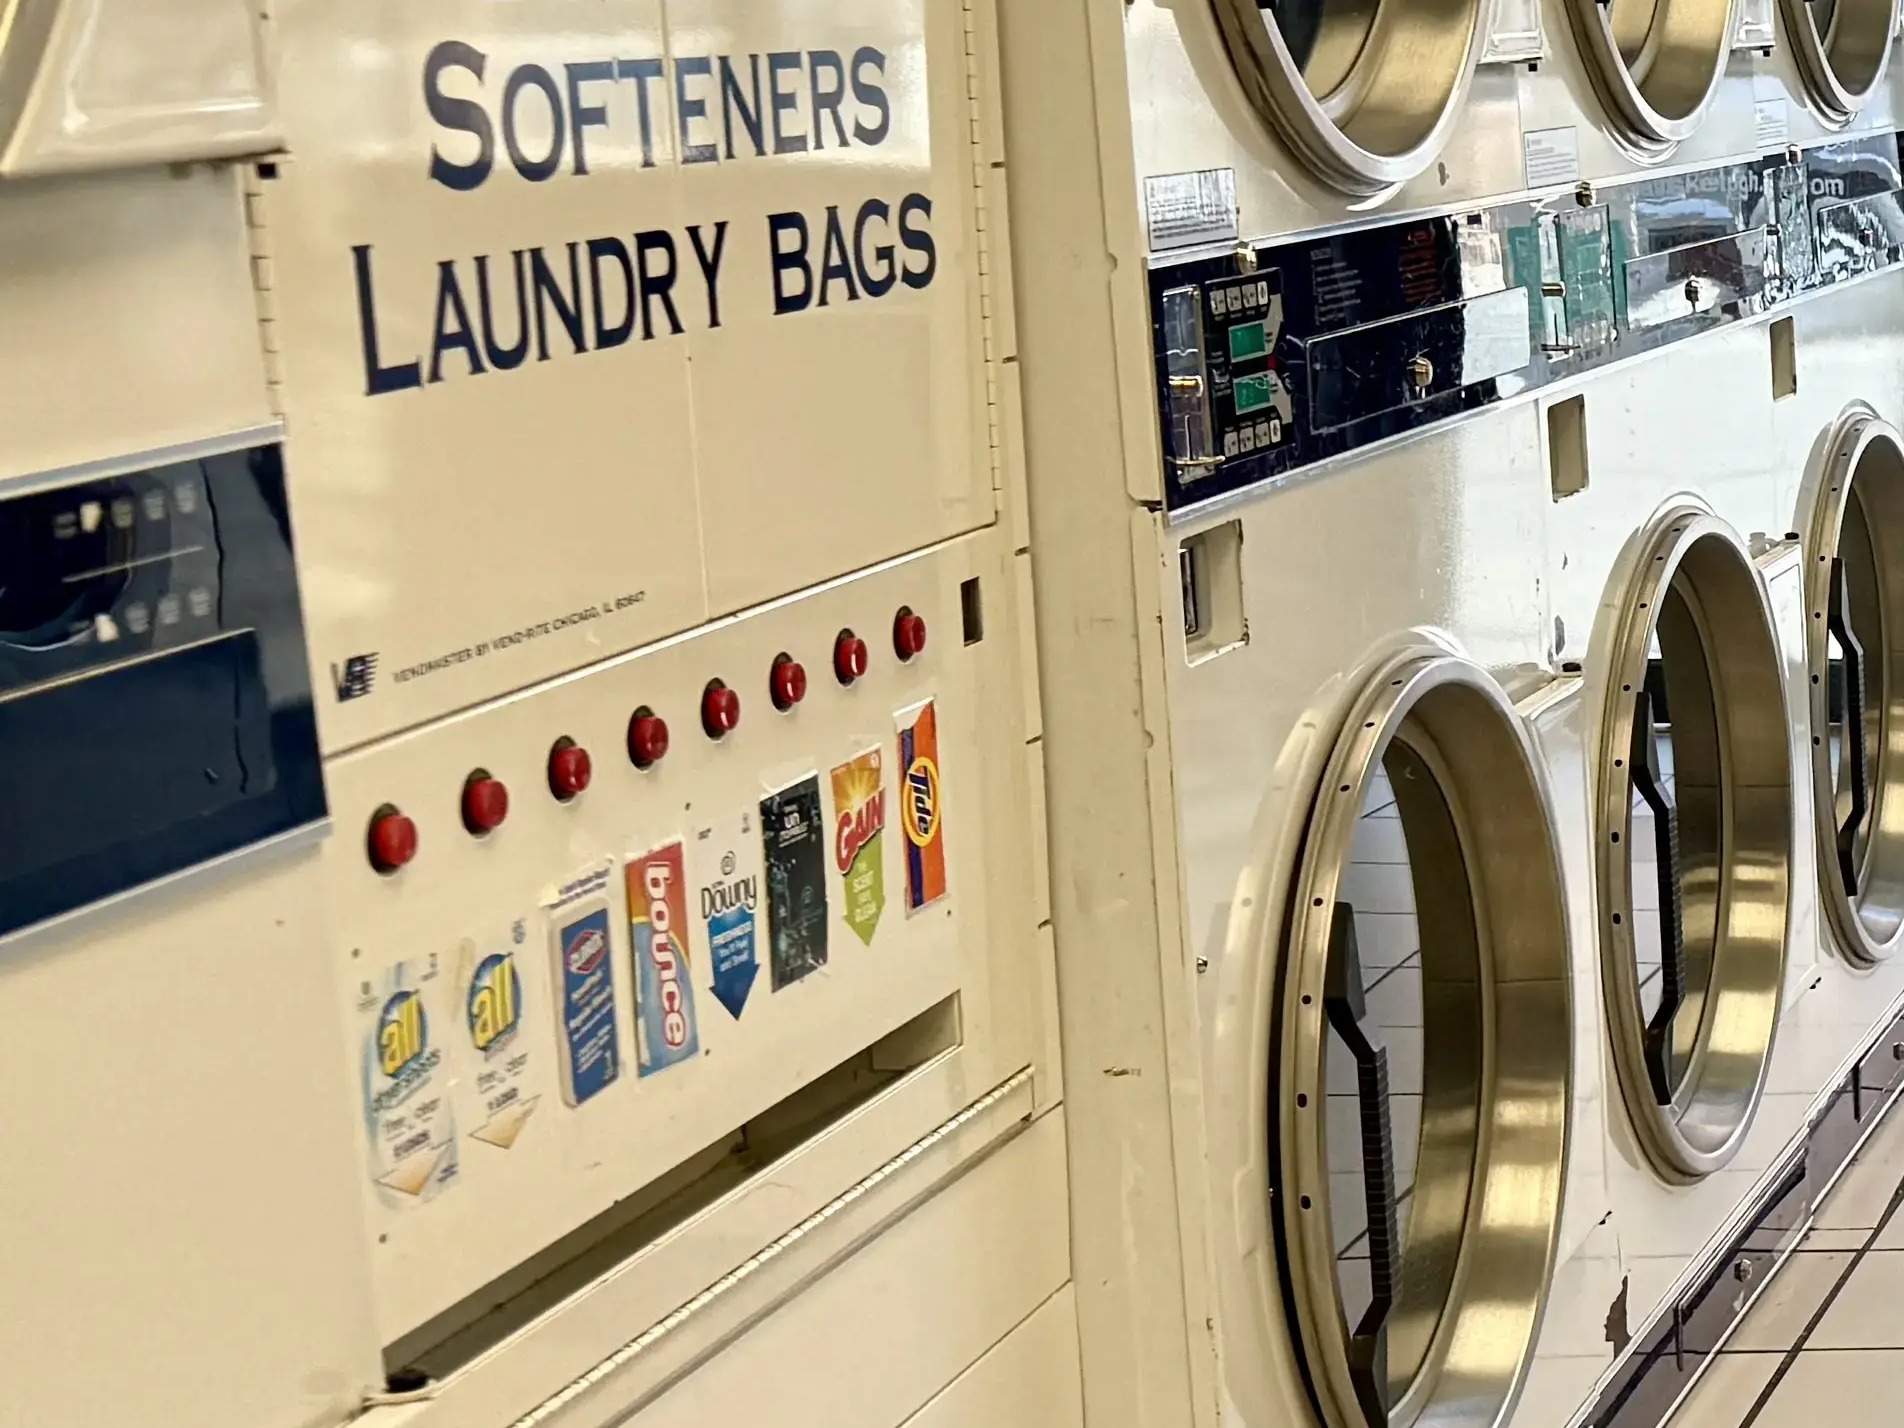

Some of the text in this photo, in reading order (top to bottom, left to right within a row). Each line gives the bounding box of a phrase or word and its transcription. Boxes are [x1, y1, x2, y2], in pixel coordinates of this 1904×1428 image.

[422, 40, 892, 192] SOFTENERS
[350, 192, 938, 399] LAUNDRY BAGS
[836, 787, 885, 874] GAIN
[908, 771, 931, 837] Tide
[701, 874, 757, 920] Downy
[646, 862, 686, 1048] bounce
[380, 994, 420, 1078] all
[472, 958, 516, 1051] all
